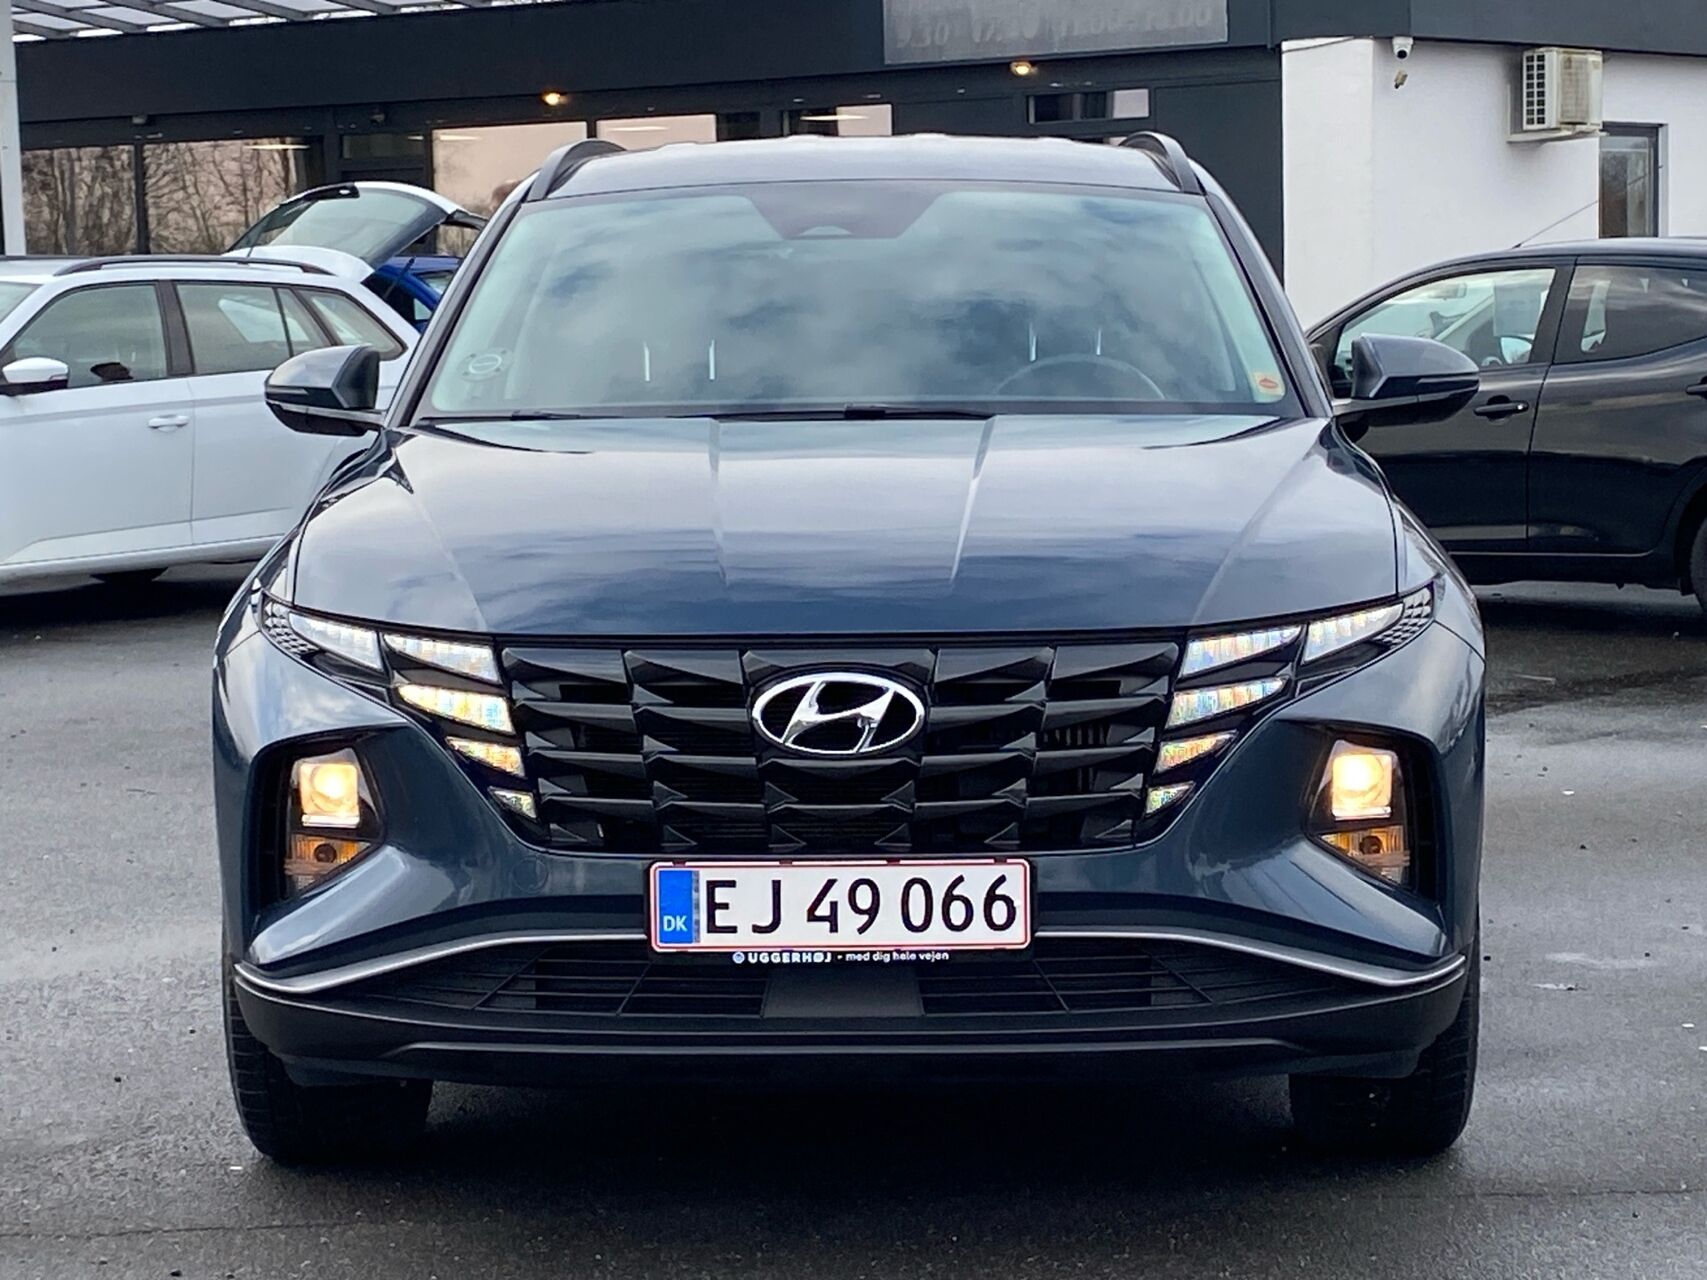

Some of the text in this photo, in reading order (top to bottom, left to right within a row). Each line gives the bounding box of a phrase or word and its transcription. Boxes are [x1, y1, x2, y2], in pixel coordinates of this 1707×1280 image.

[706, 874, 1018, 935] EJ 49 066
[662, 915, 688, 932] DK
[747, 951, 833, 964] UGGERHØJ
[845, 951, 871, 962] med
[872, 951, 891, 963] dig
[918, 950, 950, 963] vejen
